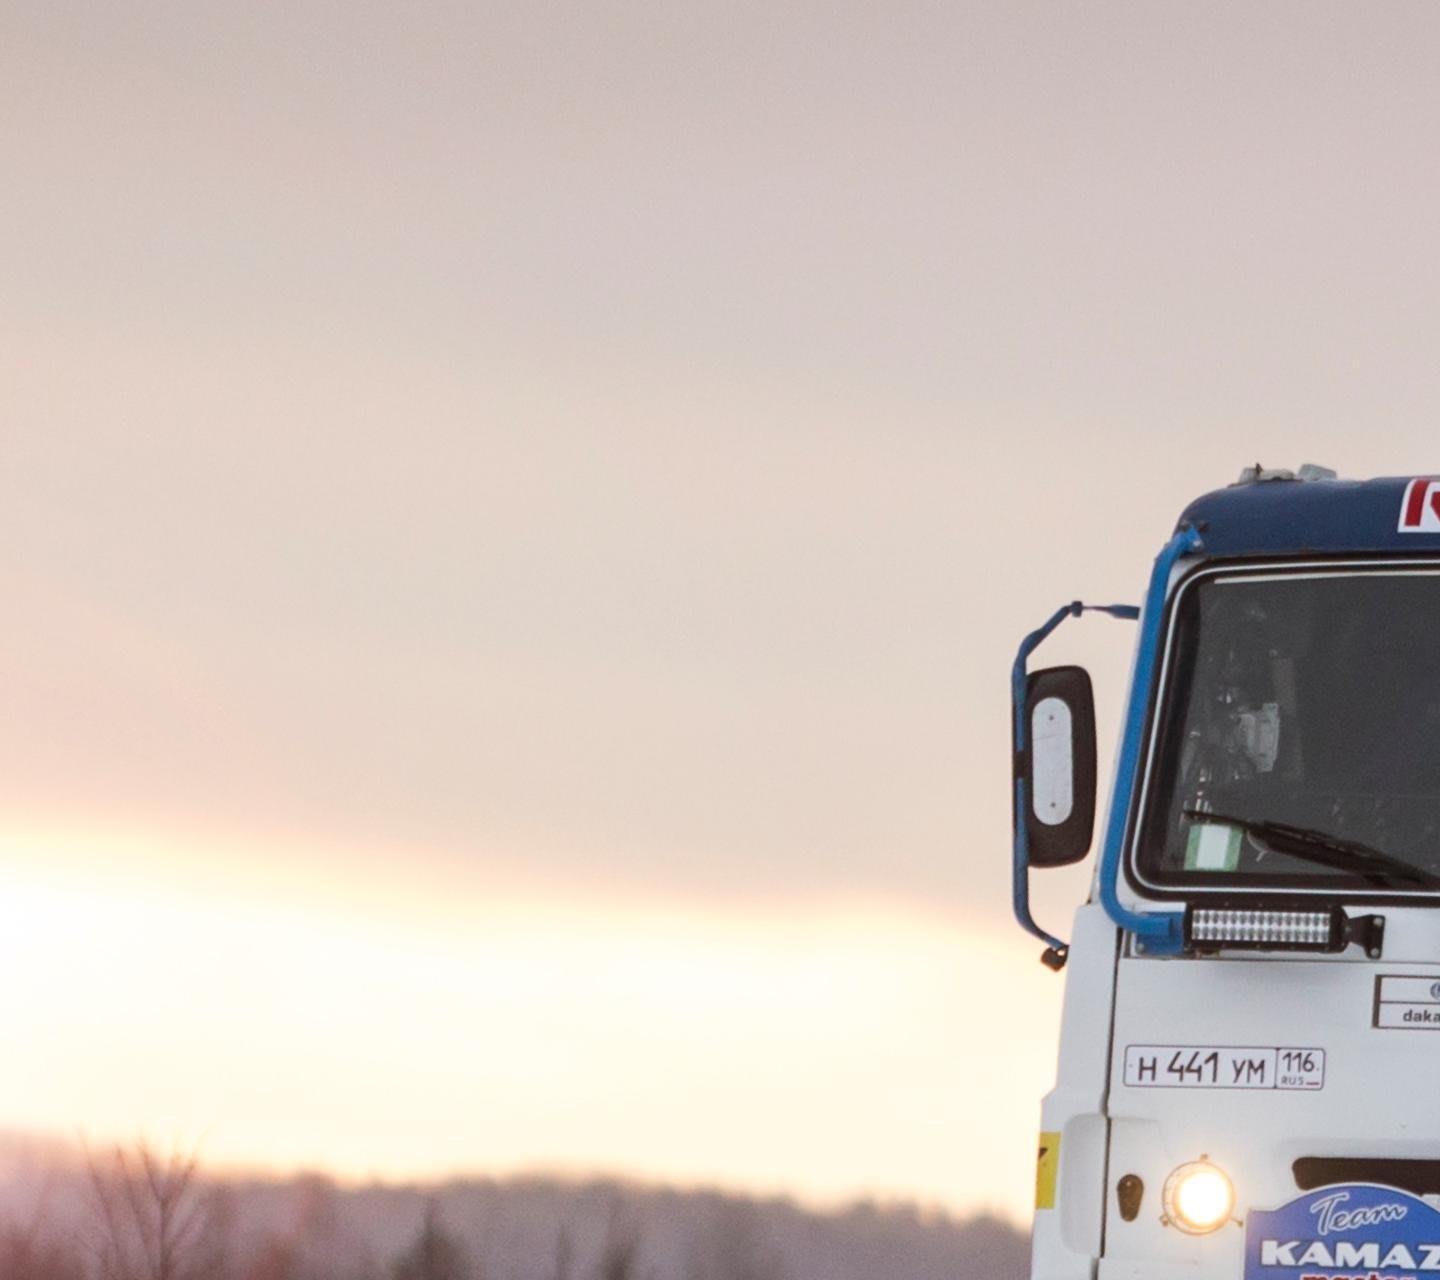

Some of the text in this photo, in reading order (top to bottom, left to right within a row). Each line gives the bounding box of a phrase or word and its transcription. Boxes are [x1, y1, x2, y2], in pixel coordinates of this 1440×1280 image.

[1166, 1050, 1219, 1083] 441
[1282, 1052, 1315, 1072] 116
[1281, 1076, 1305, 1086] RUS
[1311, 1192, 1407, 1235] Team
